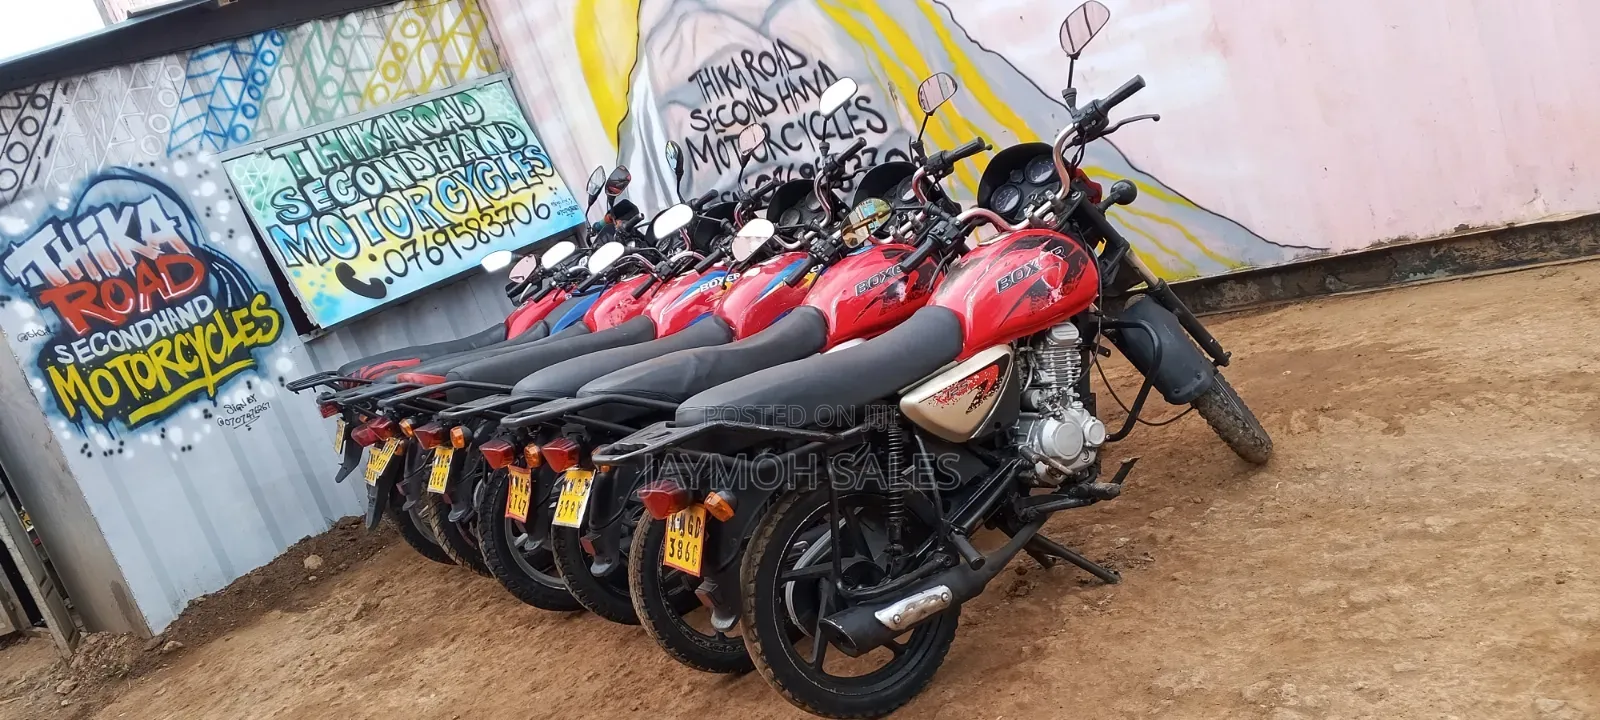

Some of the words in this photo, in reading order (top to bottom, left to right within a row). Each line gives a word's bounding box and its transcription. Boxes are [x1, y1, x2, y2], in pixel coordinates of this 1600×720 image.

[267, 145, 555, 268] MOTORCYCLES
[39, 253, 206, 335] ROAD
[54, 294, 215, 364] SECONDHAND
[47, 293, 282, 420] MOTORCYCLES
